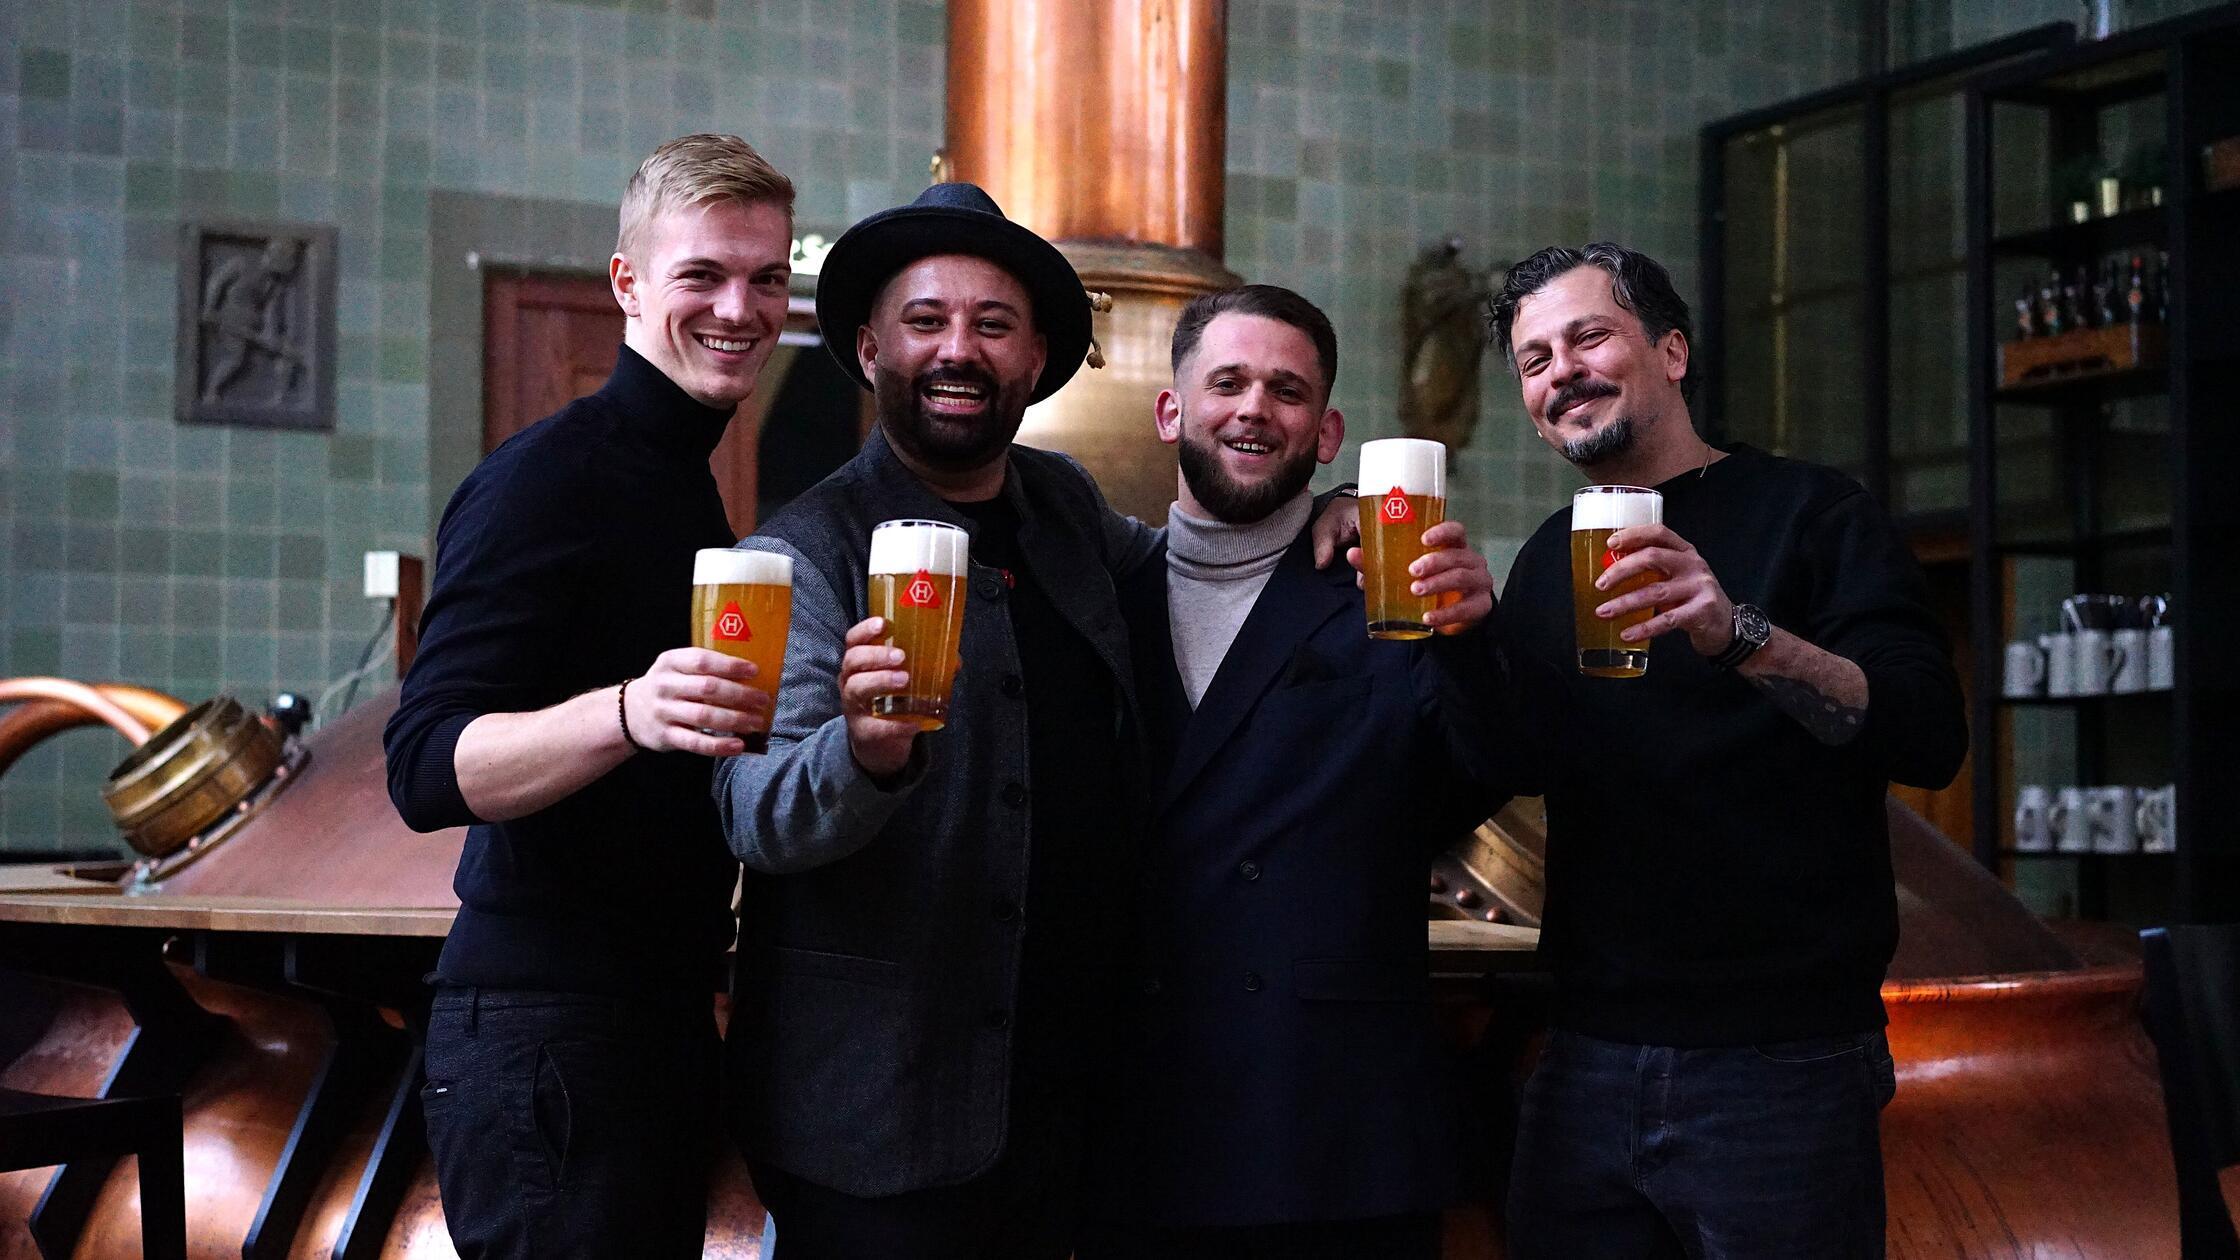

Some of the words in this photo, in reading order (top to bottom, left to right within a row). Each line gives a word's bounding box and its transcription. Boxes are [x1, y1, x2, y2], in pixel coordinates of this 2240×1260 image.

[1390, 501, 1402, 515] H
[916, 584, 928, 599] H
[725, 617, 738, 632] H
